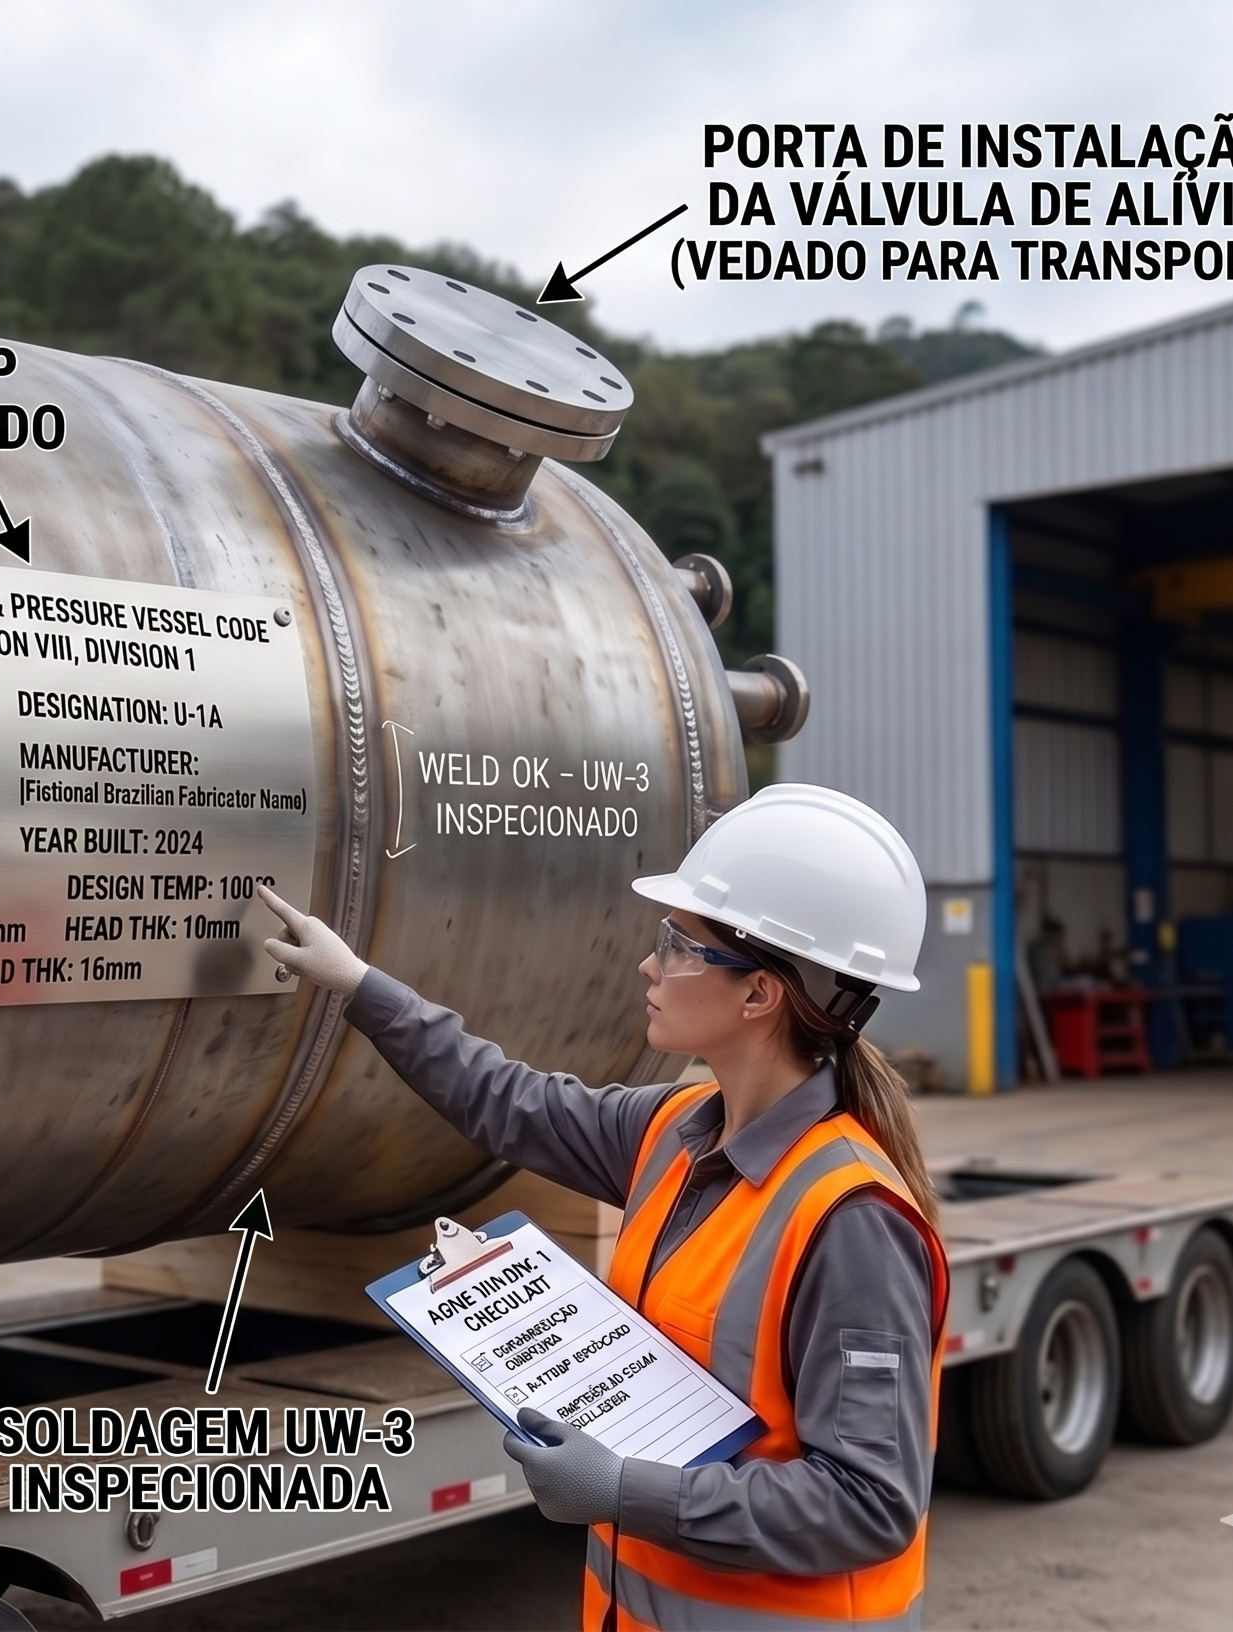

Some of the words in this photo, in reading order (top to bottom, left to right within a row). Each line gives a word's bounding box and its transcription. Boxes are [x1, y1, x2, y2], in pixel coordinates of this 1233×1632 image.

[10, 592, 128, 629] PRESSURE
[131, 605, 212, 637] VESSEL
[216, 615, 270, 643] CODE
[34, 632, 79, 666] VIII,
[84, 637, 180, 670] DIVISION
[184, 647, 195, 672] 1
[17, 690, 168, 725] DESIGNATION:
[174, 701, 224, 729] U-1A
[20, 742, 199, 776] MANUFACTURER:
[418, 751, 500, 786] WELD
[512, 755, 550, 789] OK
[583, 759, 650, 792] UW-3
[104, 782, 175, 806] Brazilian
[178, 785, 257, 809] Fabricator
[437, 802, 638, 837] INSPECIONADO
[19, 826, 78, 853] YEAR
[84, 828, 149, 855] BUILT:
[154, 829, 204, 855] 2024
[67, 874, 145, 901] DESIGN
[150, 874, 214, 901] TEMP:
[64, 915, 123, 942] HEAD
[128, 915, 177, 941] THK:
[183, 914, 241, 940] 10mm
[21, 956, 74, 984] THK:
[80, 956, 142, 982] 16mm
